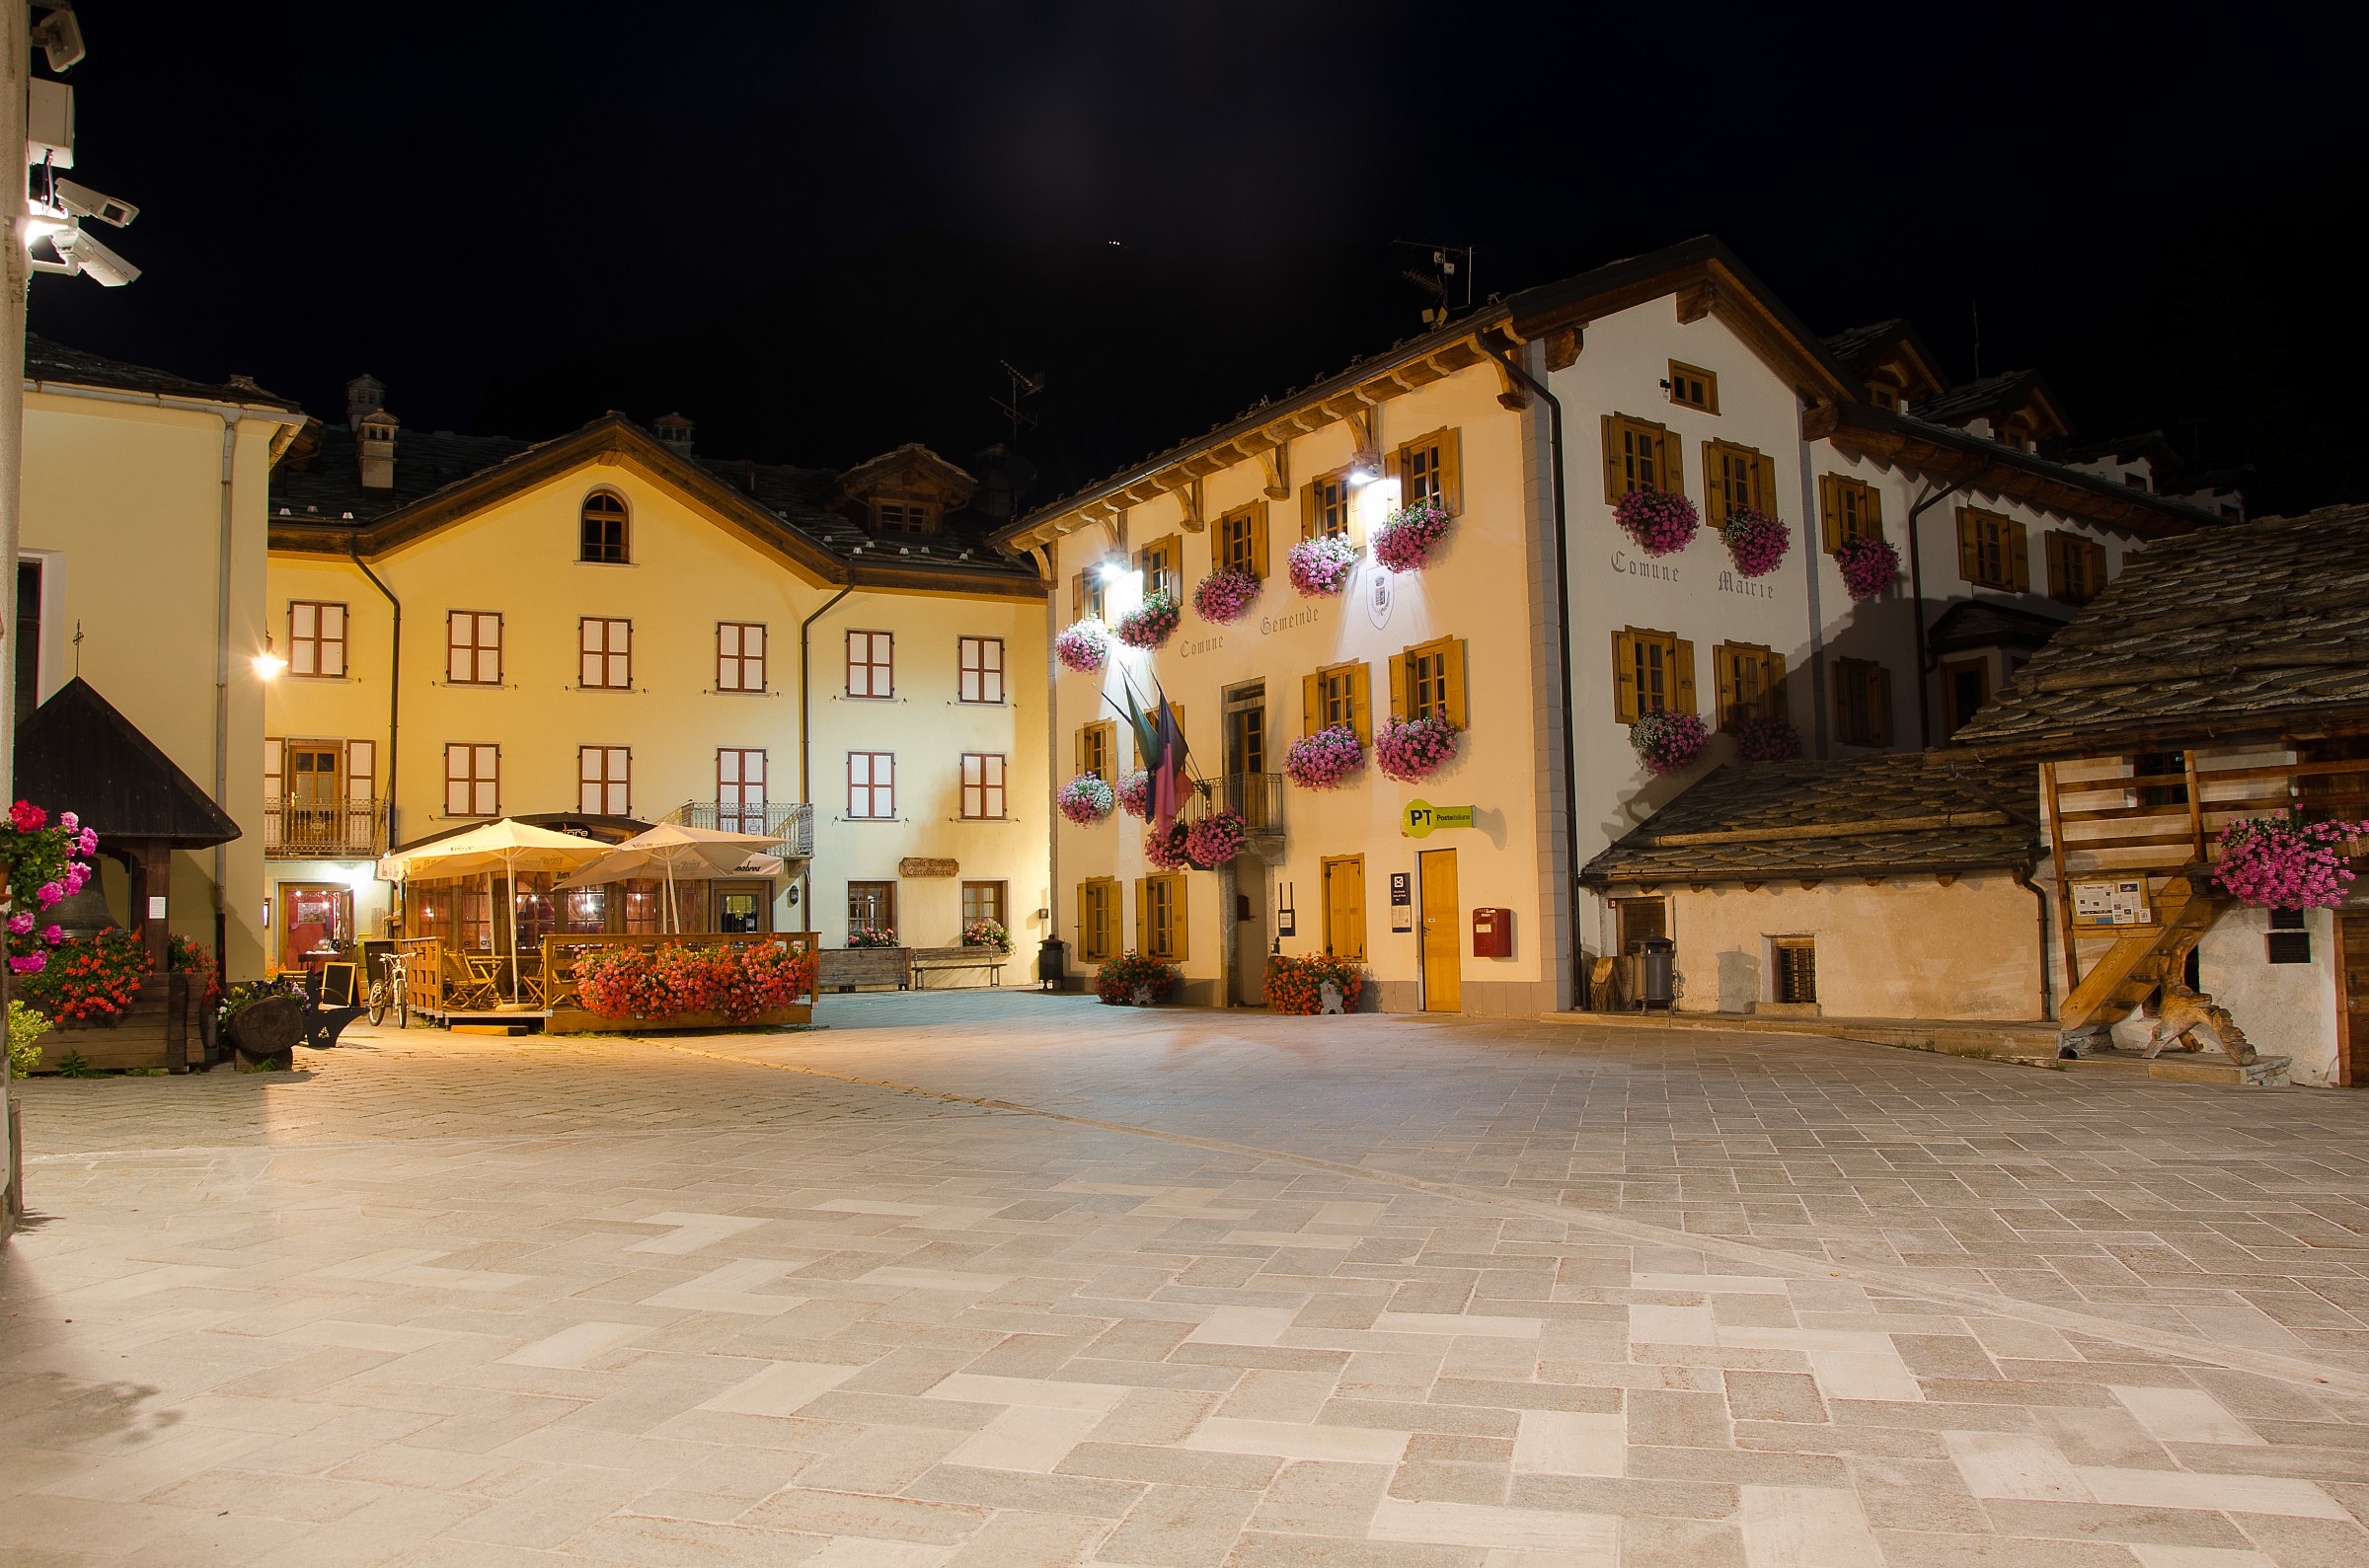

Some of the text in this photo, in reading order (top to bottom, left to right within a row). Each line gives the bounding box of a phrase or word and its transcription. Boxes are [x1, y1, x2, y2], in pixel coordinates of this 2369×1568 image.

[1610, 550, 1774, 599] Comune Mairie
[1180, 605, 1320, 658] Comune Gemeinde
[1410, 809, 1432, 827] PT
